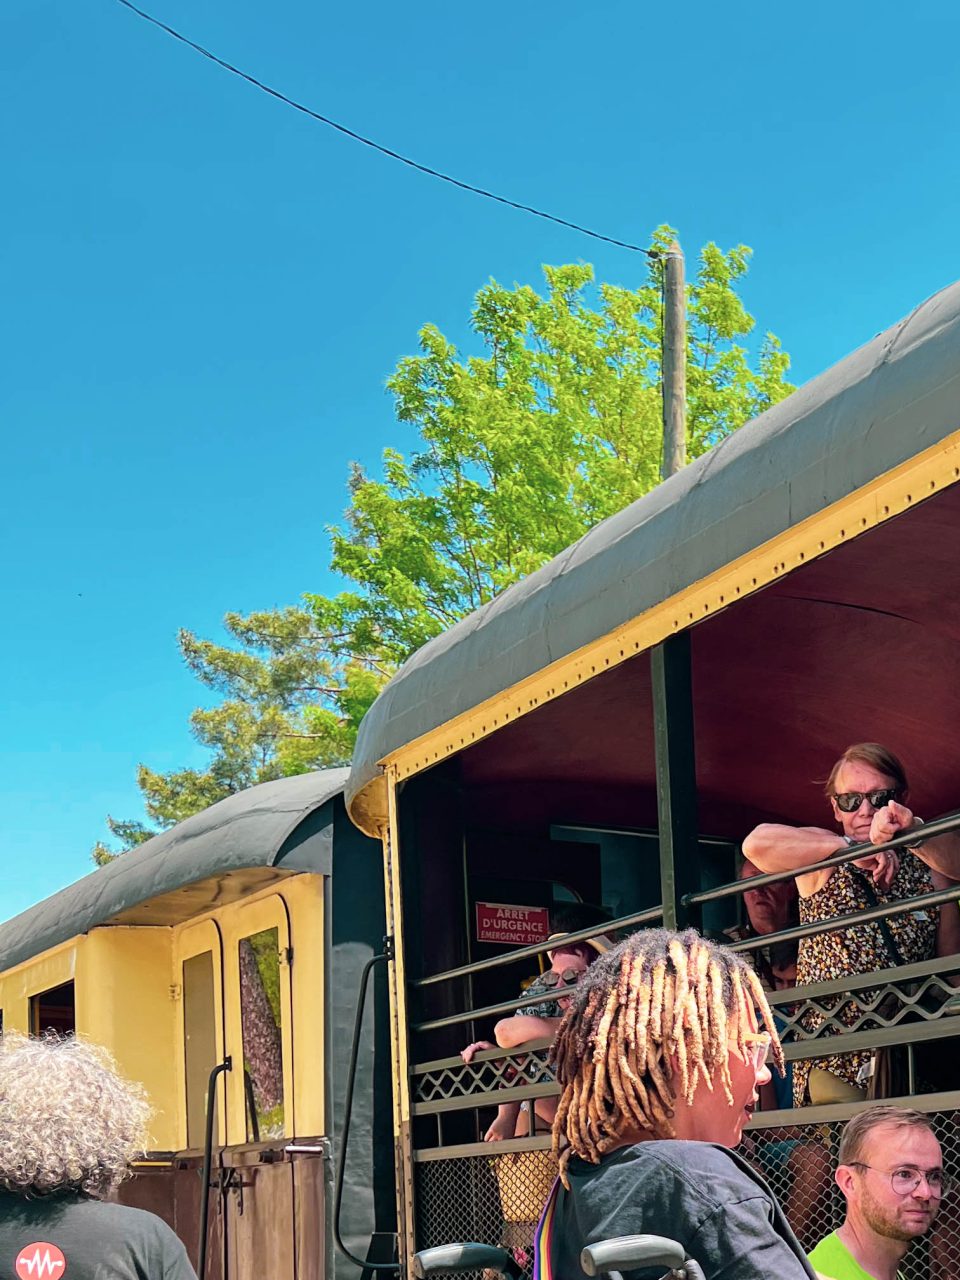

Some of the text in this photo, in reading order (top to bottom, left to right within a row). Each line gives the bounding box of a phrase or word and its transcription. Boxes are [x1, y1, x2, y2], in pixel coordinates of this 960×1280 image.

[496, 909, 529, 919] ARRET
[483, 918, 543, 932] D'URGENCE
[481, 930, 524, 942] EMERGENCY
